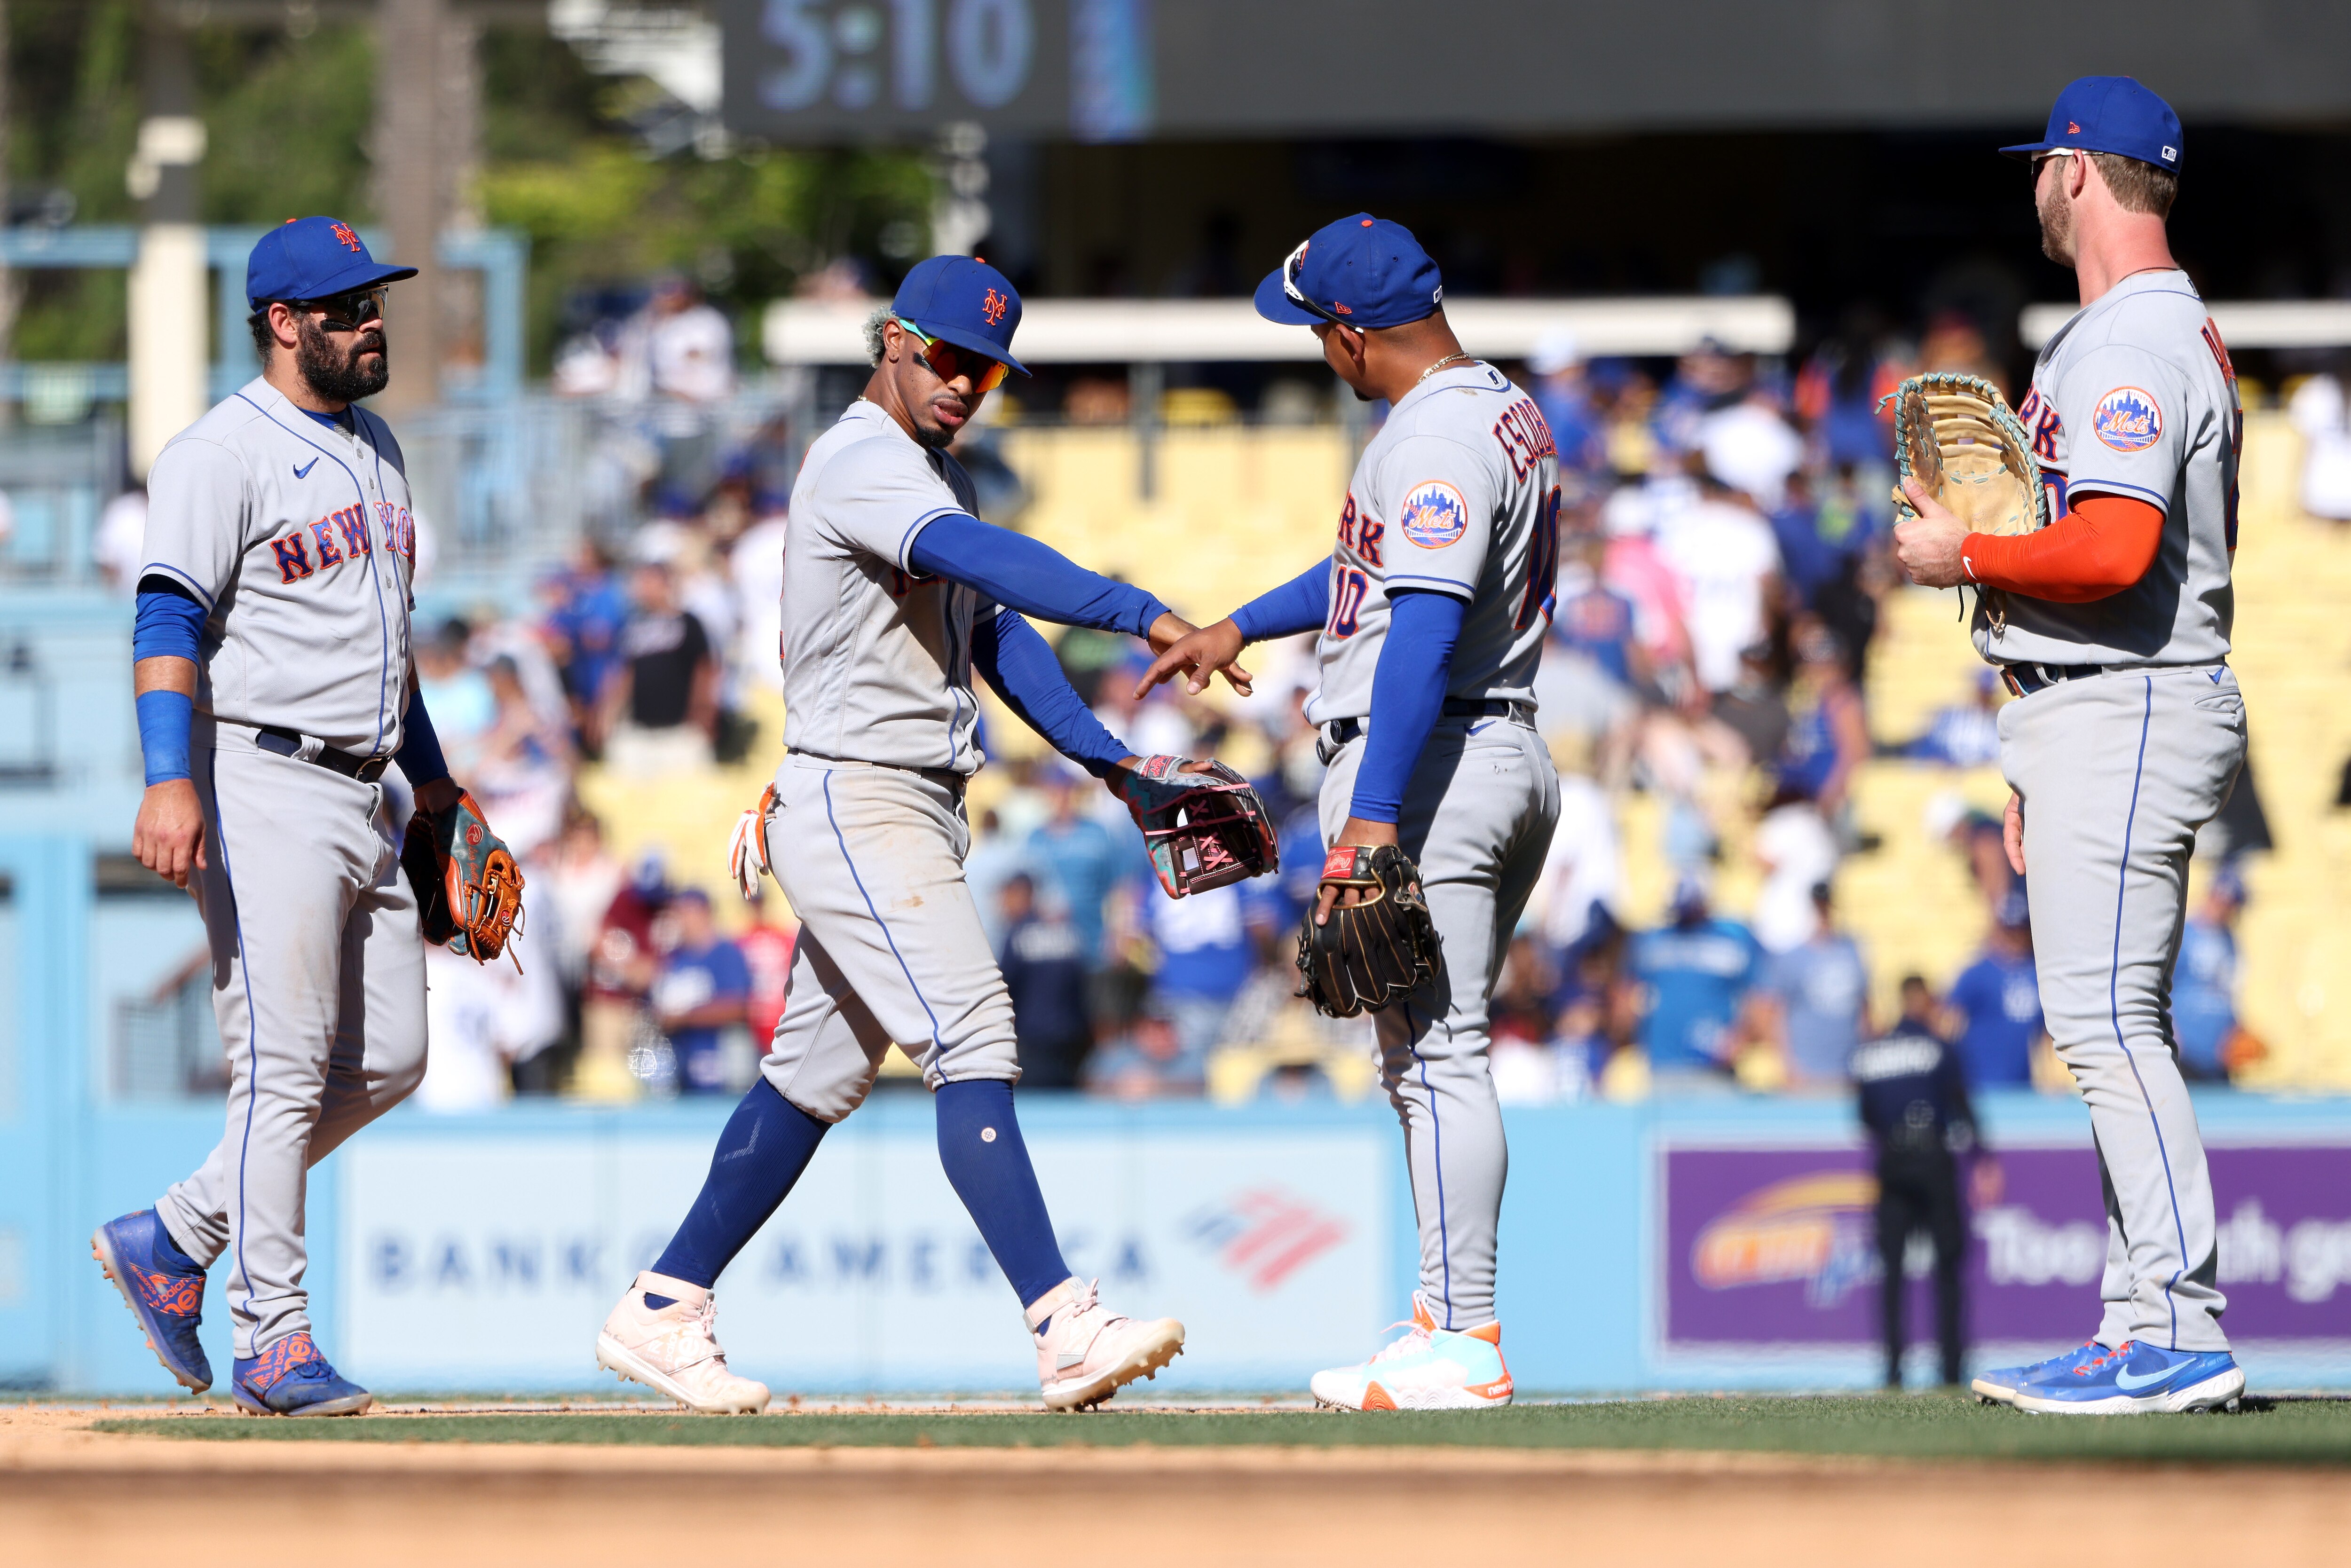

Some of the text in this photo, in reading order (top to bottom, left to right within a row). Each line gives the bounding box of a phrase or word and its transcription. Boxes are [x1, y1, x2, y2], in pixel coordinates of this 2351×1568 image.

[758, 0, 1033, 111] 5:10
[2016, 380, 2062, 462] RK
[2102, 410, 2151, 434] Mets
[269, 501, 416, 584] NEW YO
[1337, 484, 1385, 567] RK
[1409, 506, 1456, 529] Mets
[1327, 565, 1369, 639] 10
[371, 1232, 604, 1294] BANK
[767, 1232, 1158, 1295] AMERA
[1972, 1206, 2103, 1284] Too
[158, 1278, 189, 1303] balan
